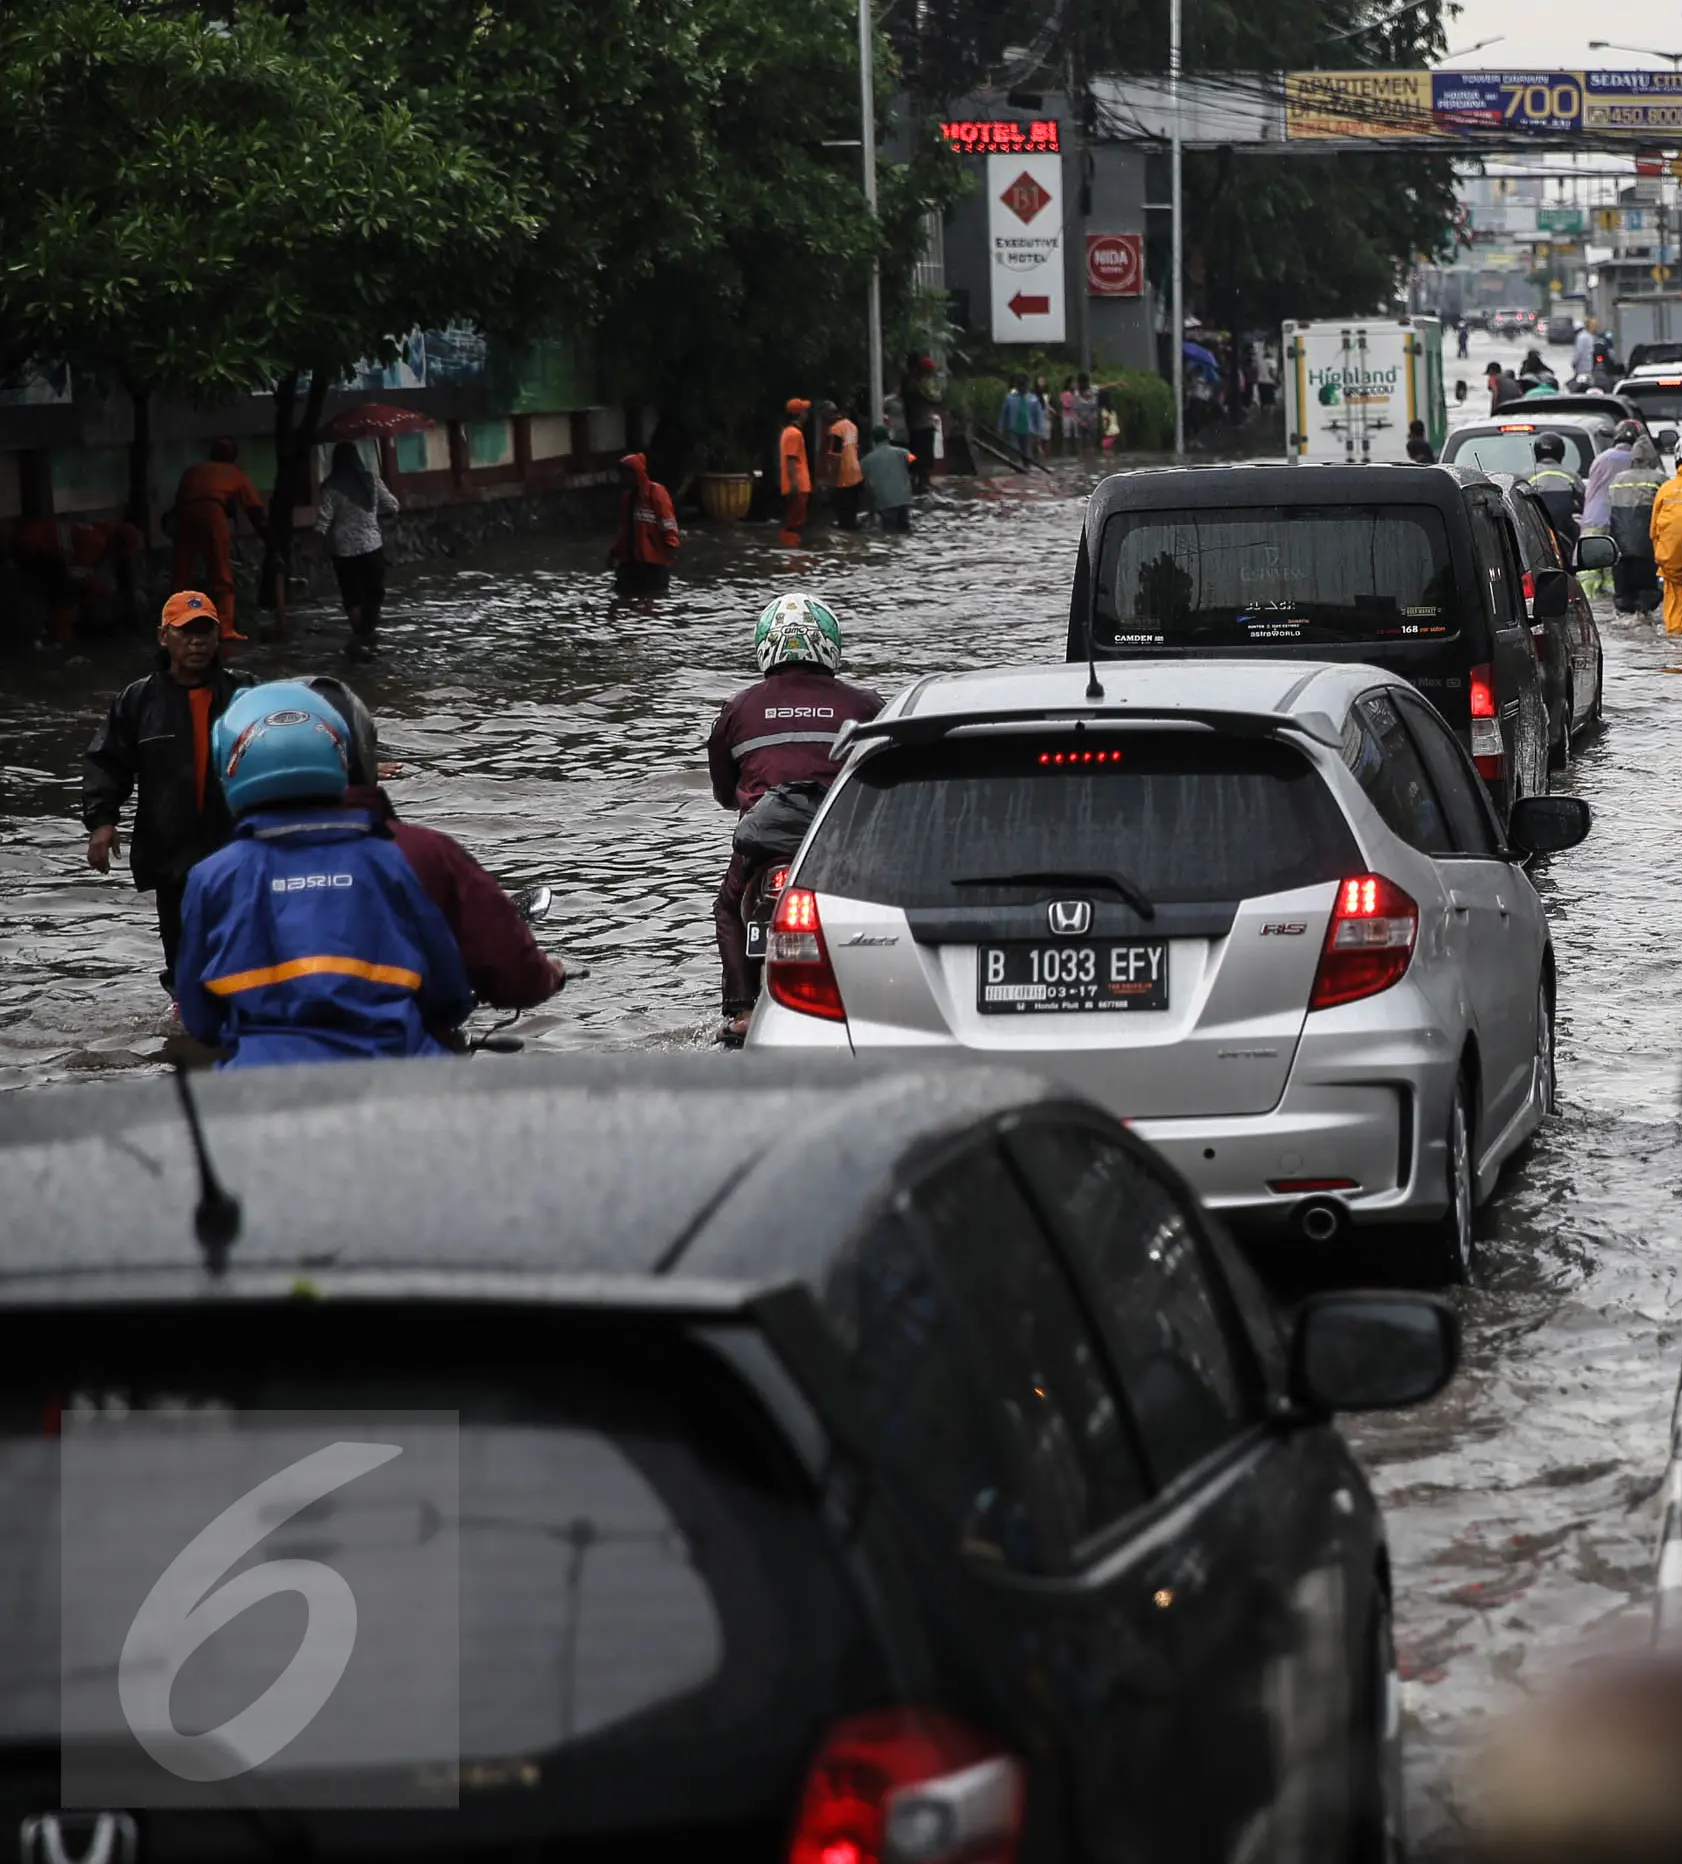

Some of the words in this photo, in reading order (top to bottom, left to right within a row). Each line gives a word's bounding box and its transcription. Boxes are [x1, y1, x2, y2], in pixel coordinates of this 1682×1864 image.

[1590, 73, 1650, 86] SEDAYU
[1500, 85, 1579, 118] 700
[940, 121, 1026, 143] HOTEL
[995, 237, 1060, 249] EXECUTIVE
[1007, 252, 1048, 264] HOTEL
[1093, 250, 1129, 266] NIDA
[1309, 365, 1397, 388] Highland
[1401, 625, 1418, 634] 168
[1114, 634, 1153, 642] CAMDEN
[1260, 922, 1307, 936] RS
[988, 949, 1005, 983] B
[1030, 949, 1096, 983] 1033
[1110, 946, 1163, 982] EFY
